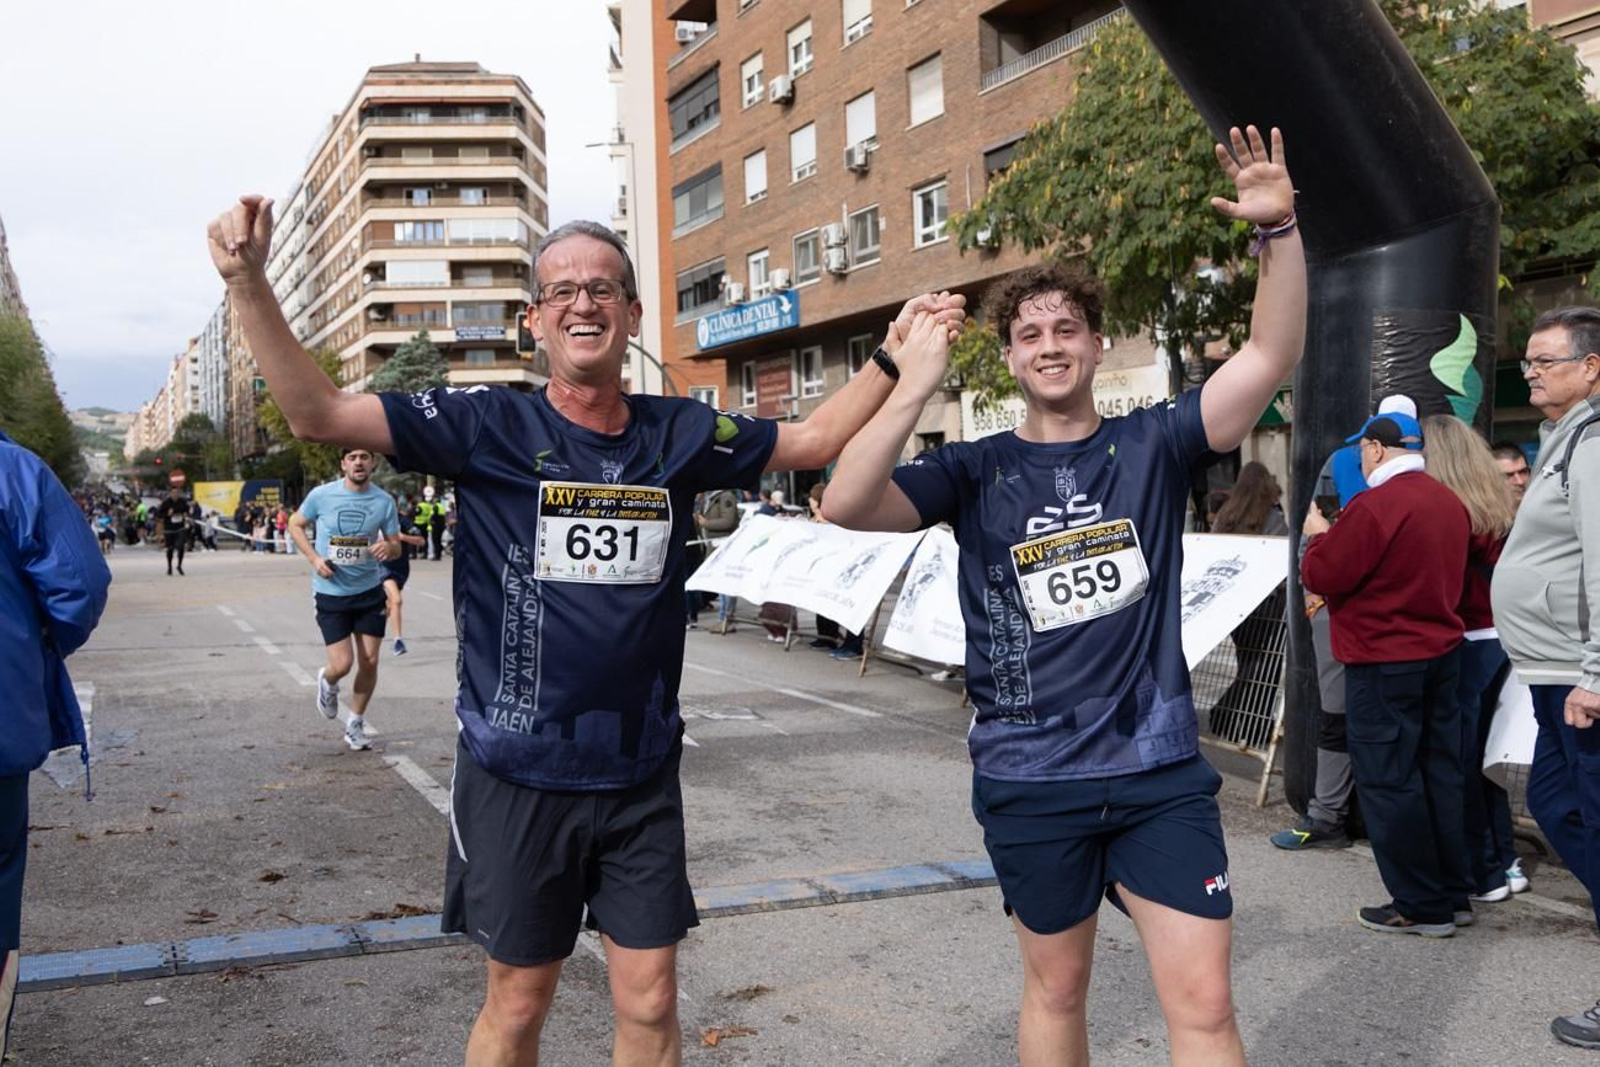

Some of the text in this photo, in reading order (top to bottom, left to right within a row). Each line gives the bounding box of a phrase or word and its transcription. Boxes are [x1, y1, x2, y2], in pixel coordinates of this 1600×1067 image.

[742, 300, 779, 326] DENTAL
[997, 410, 1016, 429] 650
[1098, 398, 1123, 416] 045
[545, 487, 664, 506] XXV CARRERA POPULAR
[577, 498, 666, 508] y gran caminata
[336, 548, 360, 559] 664
[566, 523, 639, 562] 631
[1016, 544, 1043, 566] XXV
[1043, 533, 1086, 550] CARRERA
[1086, 524, 1128, 539] POPULAR
[1045, 531, 1130, 558] y gran caminata
[1047, 560, 1122, 606] 659
[519, 574, 538, 709] DE ALEJANDRA
[990, 588, 1011, 706] SANTA CATALINA
[501, 652, 518, 704] SANTA
[1014, 683, 1026, 706] DE
[488, 706, 535, 735] JAÉN
